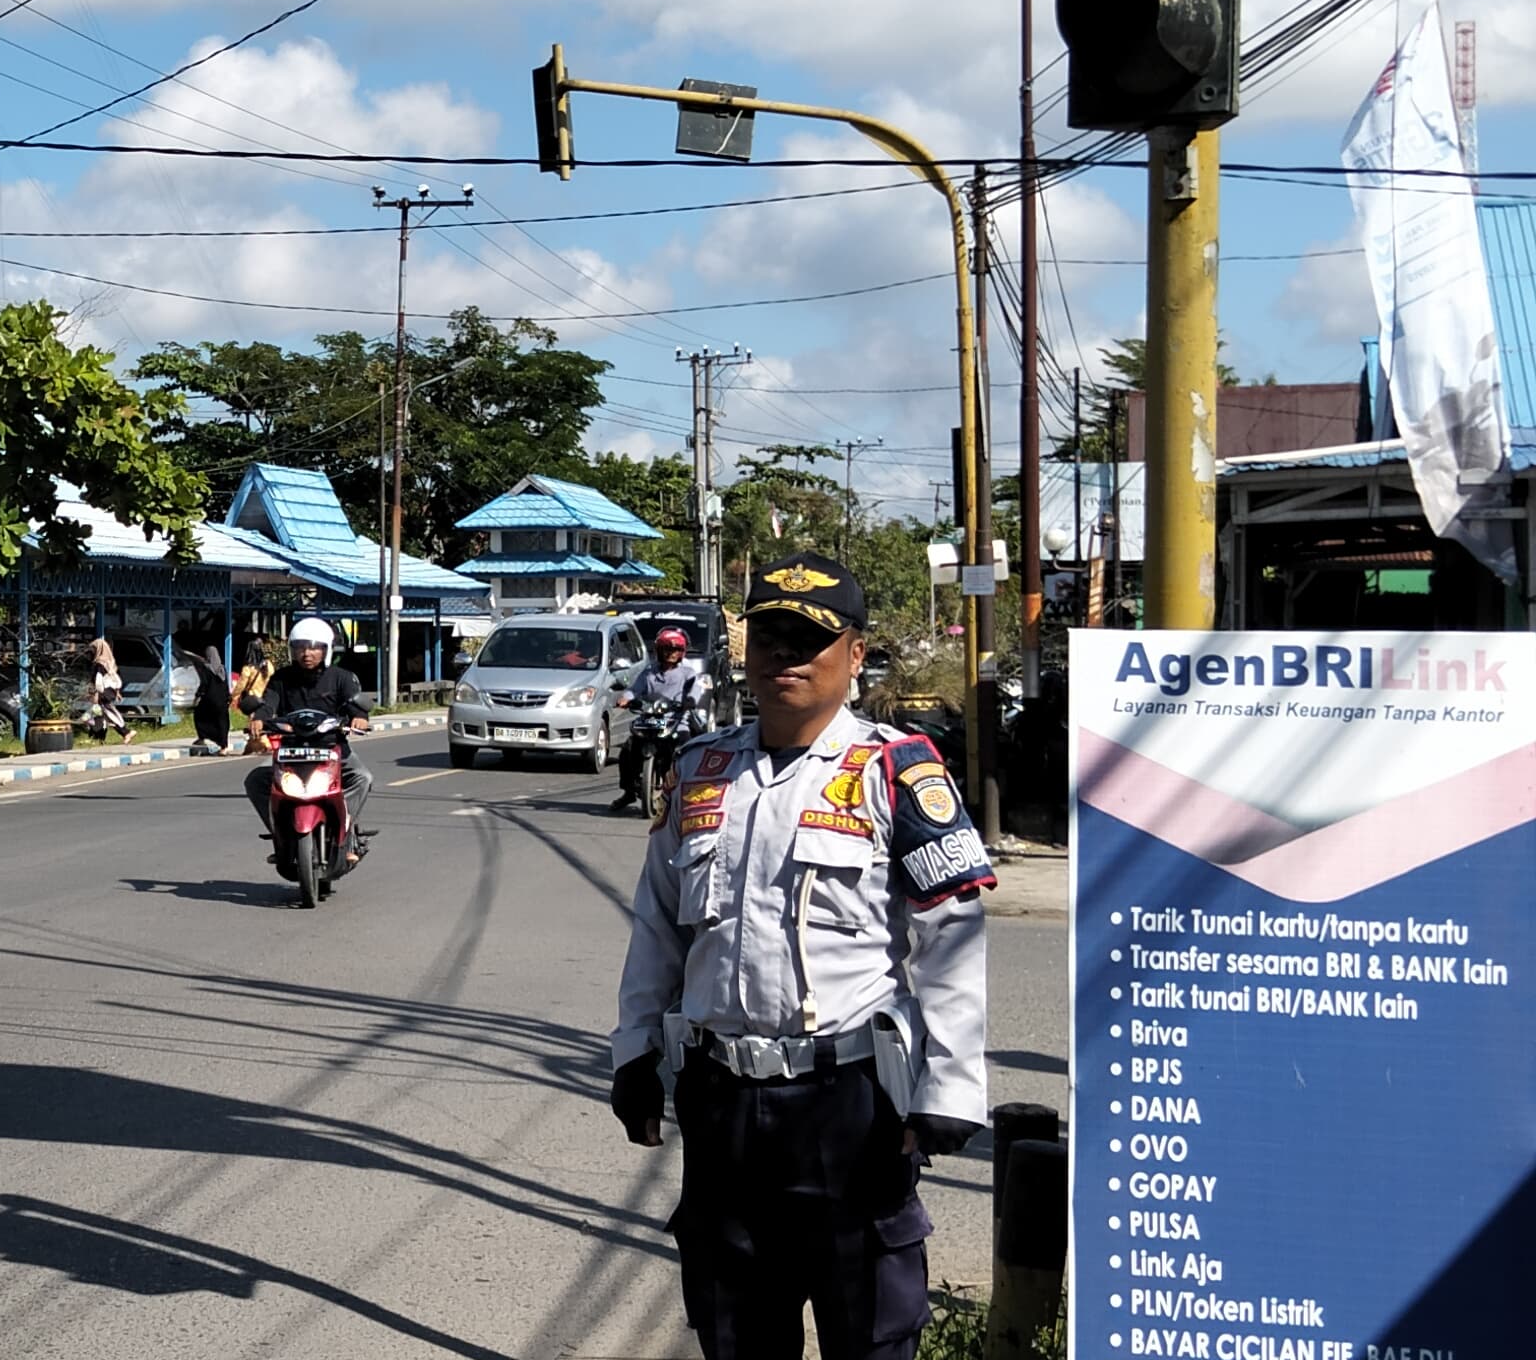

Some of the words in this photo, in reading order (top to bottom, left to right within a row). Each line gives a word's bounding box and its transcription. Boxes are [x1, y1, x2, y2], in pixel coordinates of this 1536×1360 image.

[1112, 697, 1188, 718] Layanan
[1194, 700, 1280, 718] Transaksi
[1286, 702, 1376, 723] Keuangan
[1383, 705, 1437, 724] Tanpa
[1442, 706, 1505, 723] Kantor
[1130, 907, 1185, 934] Tarik
[1191, 909, 1253, 936] Tunai
[1259, 911, 1401, 947] kartu/tanpa
[1407, 917, 1469, 946] kartu
[1130, 944, 1221, 973] Transfer
[1226, 952, 1319, 977] sesama
[1326, 951, 1361, 978] BRI
[1367, 955, 1384, 980] &
[1390, 954, 1457, 983] BANK
[1463, 957, 1508, 986] lain
[1130, 981, 1185, 1009] Tarik
[1191, 984, 1250, 1011] tunai
[1256, 986, 1368, 1018] BRI/BANK
[1374, 992, 1418, 1020] lain
[1131, 1020, 1188, 1048] Briva
[1130, 1058, 1183, 1086] BPJS
[1130, 1096, 1202, 1125] DANA
[1129, 1133, 1188, 1163] OVO
[1128, 1172, 1217, 1203] GOPAY
[1129, 1210, 1201, 1240] PULSA
[1130, 1250, 1175, 1280] Link
[1180, 1253, 1223, 1286] Aja
[1131, 1289, 1254, 1323] PLN/Token
[1261, 1295, 1325, 1328] Listrik
[1130, 1328, 1210, 1360] BAYAR
